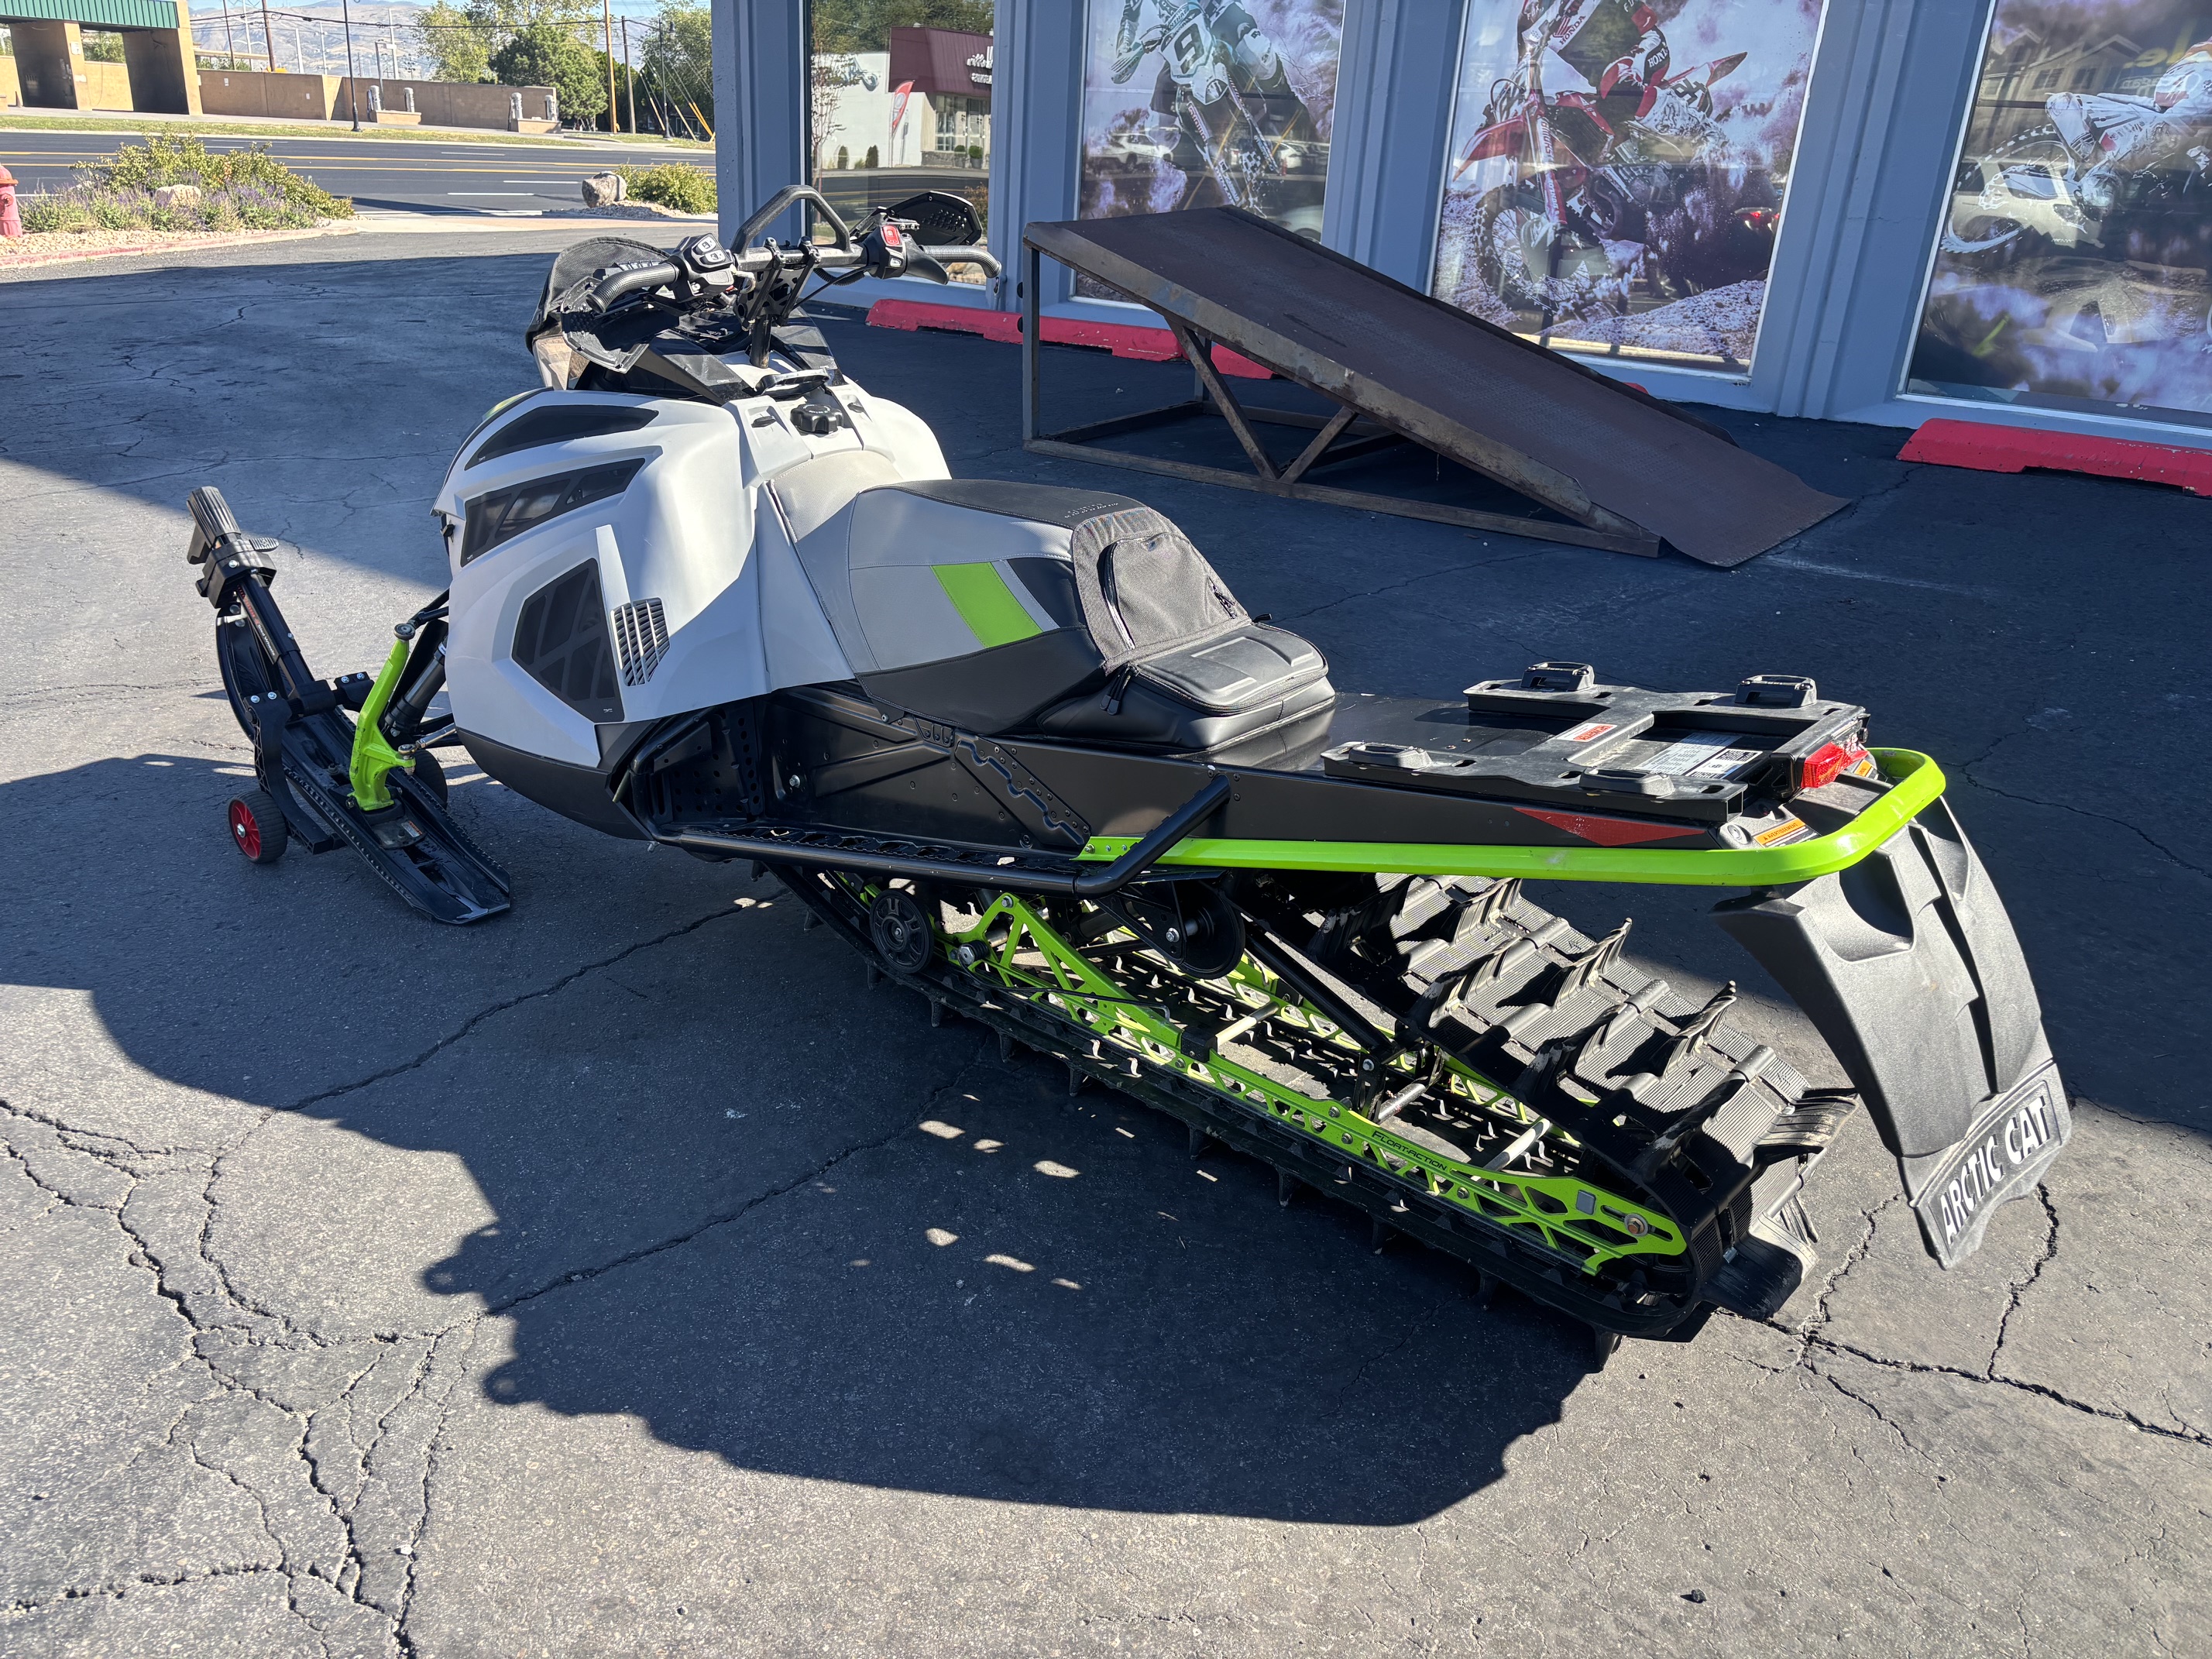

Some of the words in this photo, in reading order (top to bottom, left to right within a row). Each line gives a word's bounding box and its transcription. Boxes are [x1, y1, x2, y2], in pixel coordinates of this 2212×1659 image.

[1174, 22, 1204, 74] 9
[1560, 15, 1586, 46] HONDA
[1767, 822, 1798, 840] AVERTISSEMENT
[1940, 1135, 2004, 1245] ARCTIC
[2005, 1096, 2049, 1164] CAT
